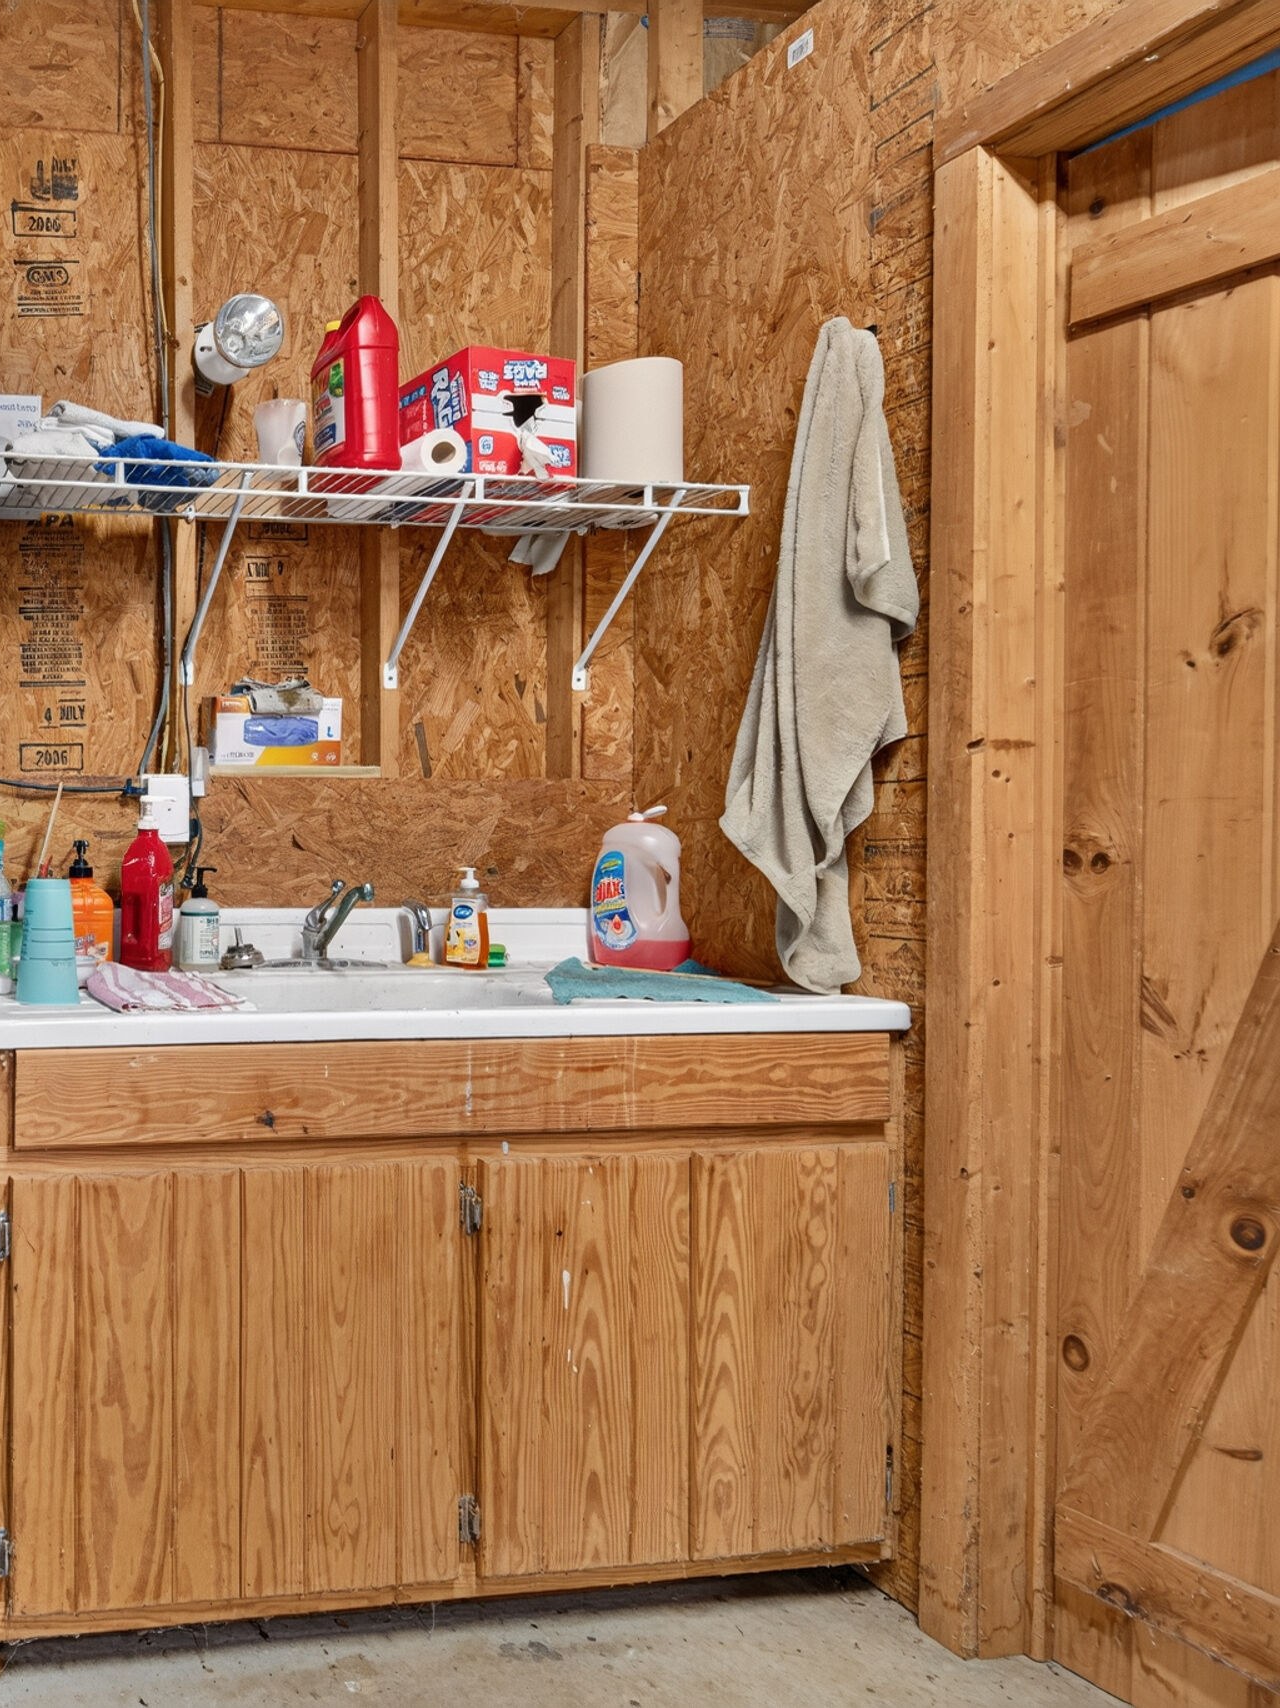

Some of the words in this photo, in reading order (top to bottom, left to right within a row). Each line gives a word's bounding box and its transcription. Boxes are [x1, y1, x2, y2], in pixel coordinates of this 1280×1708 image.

[431, 366, 453, 429] RAG
[60, 705, 86, 721] JULY
[36, 749, 68, 766] 2006
